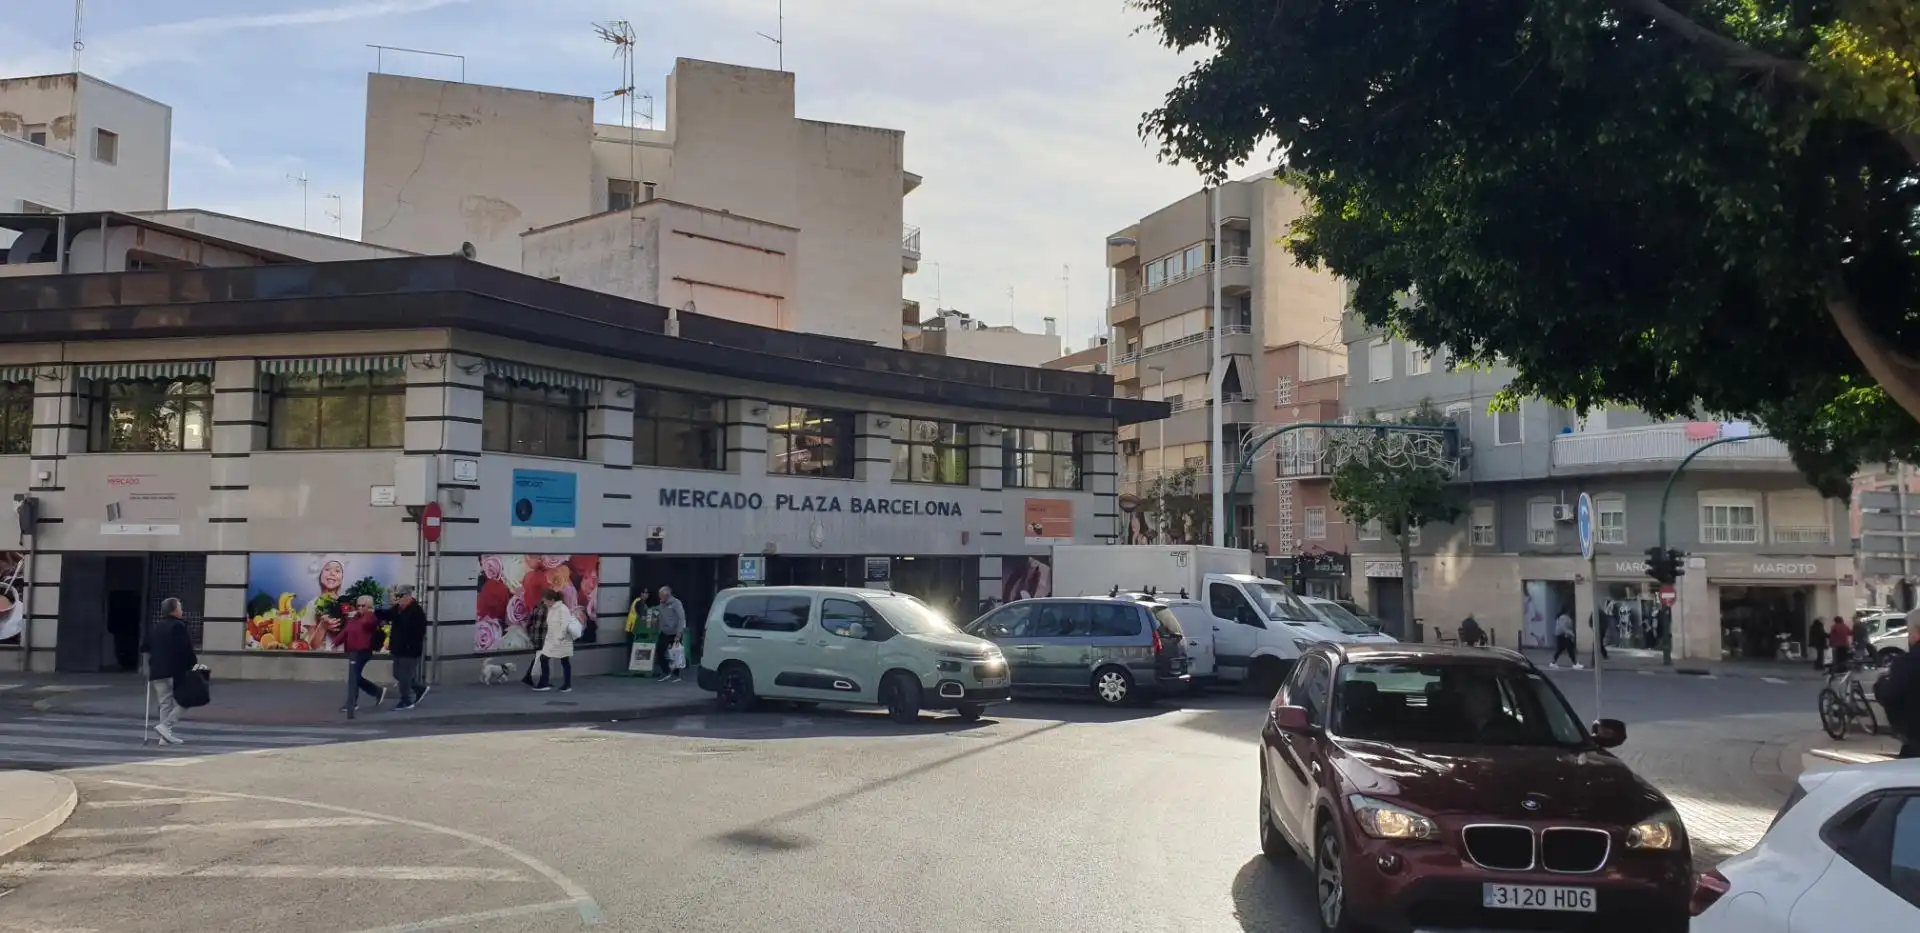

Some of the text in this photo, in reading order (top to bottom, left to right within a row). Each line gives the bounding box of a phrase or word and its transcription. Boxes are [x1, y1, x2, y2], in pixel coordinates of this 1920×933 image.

[659, 488, 962, 517] MERCADO PLAZA BARCELONA
[1616, 561, 1652, 573] MARO
[1753, 562, 1817, 575] MAROTO
[1497, 887, 1592, 908] 3120 HDG
